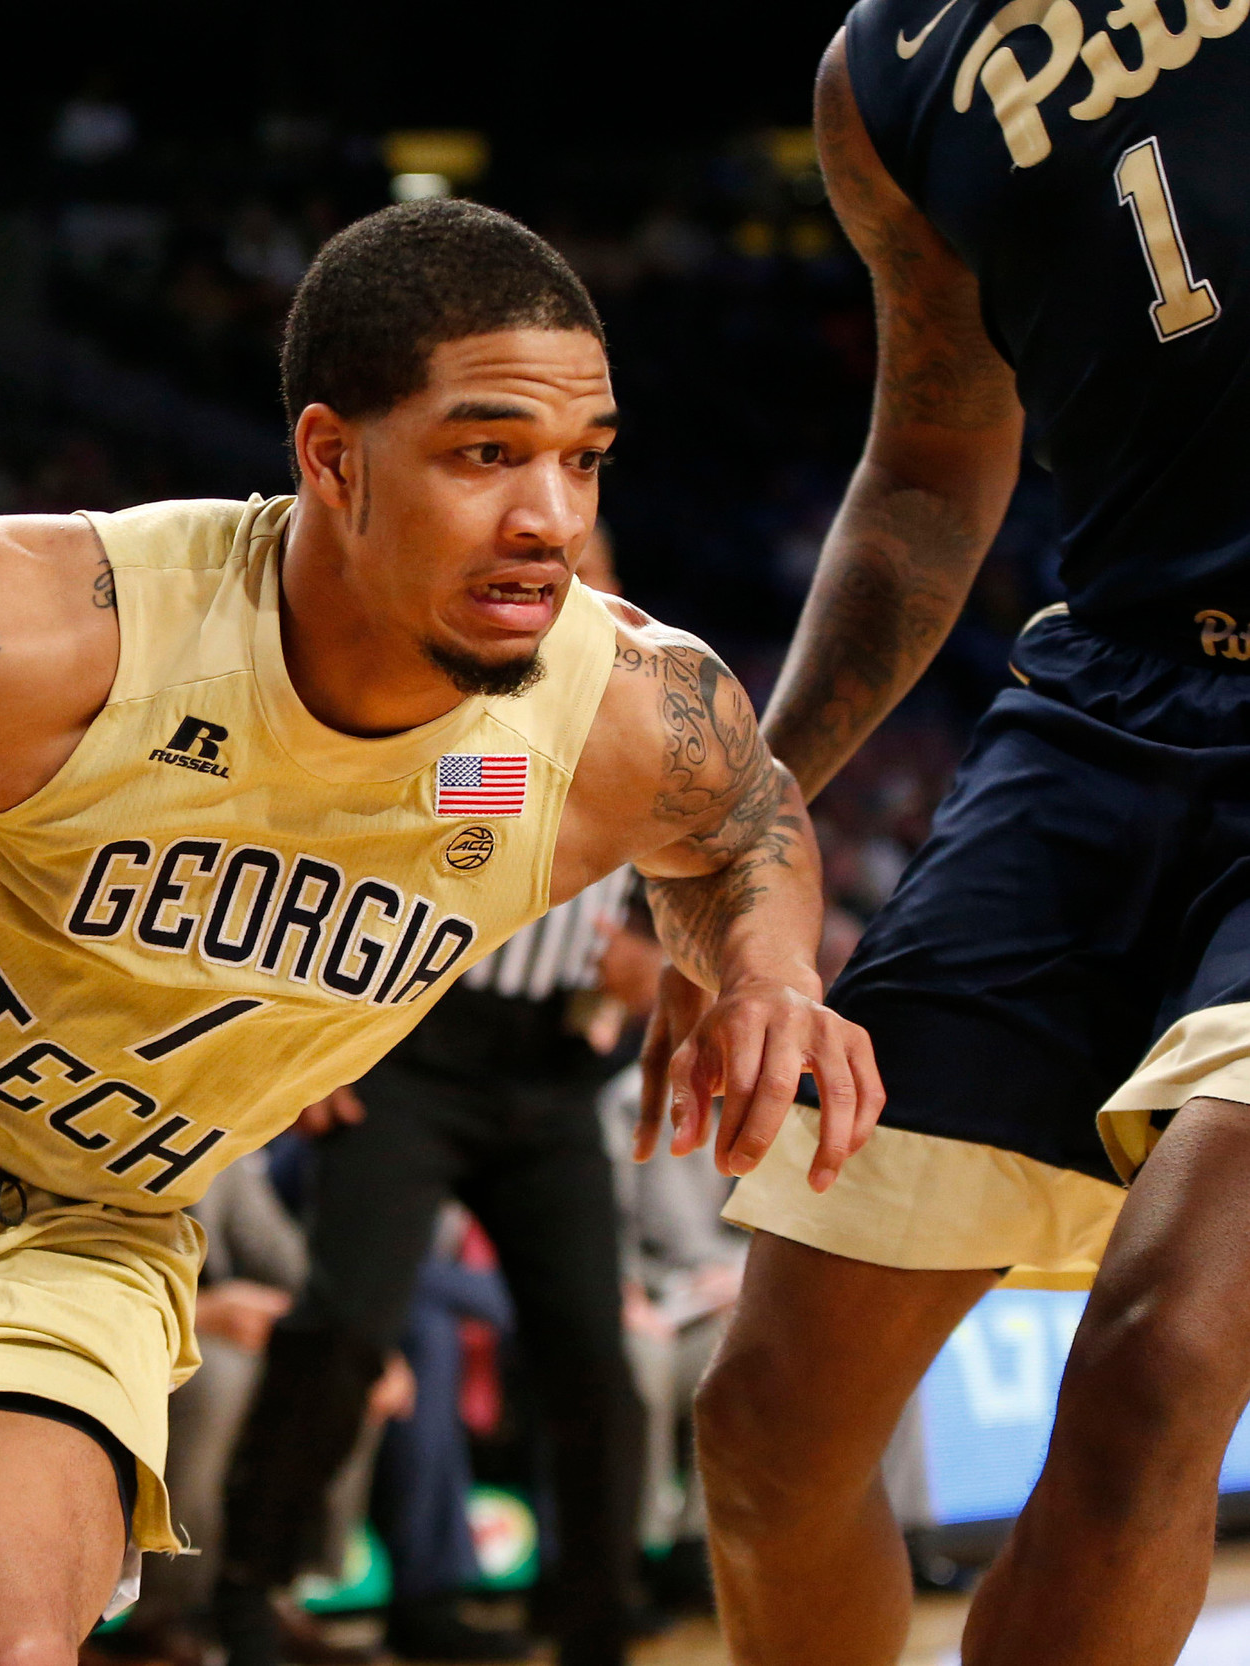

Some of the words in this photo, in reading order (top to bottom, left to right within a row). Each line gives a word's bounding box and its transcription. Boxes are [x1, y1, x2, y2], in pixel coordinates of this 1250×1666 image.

[1113, 136, 1221, 343] 1
[166, 714, 229, 761] R
[148, 749, 229, 779] RUSSELL
[451, 840, 494, 851] ACC
[63, 836, 478, 1006] GEORGIA
